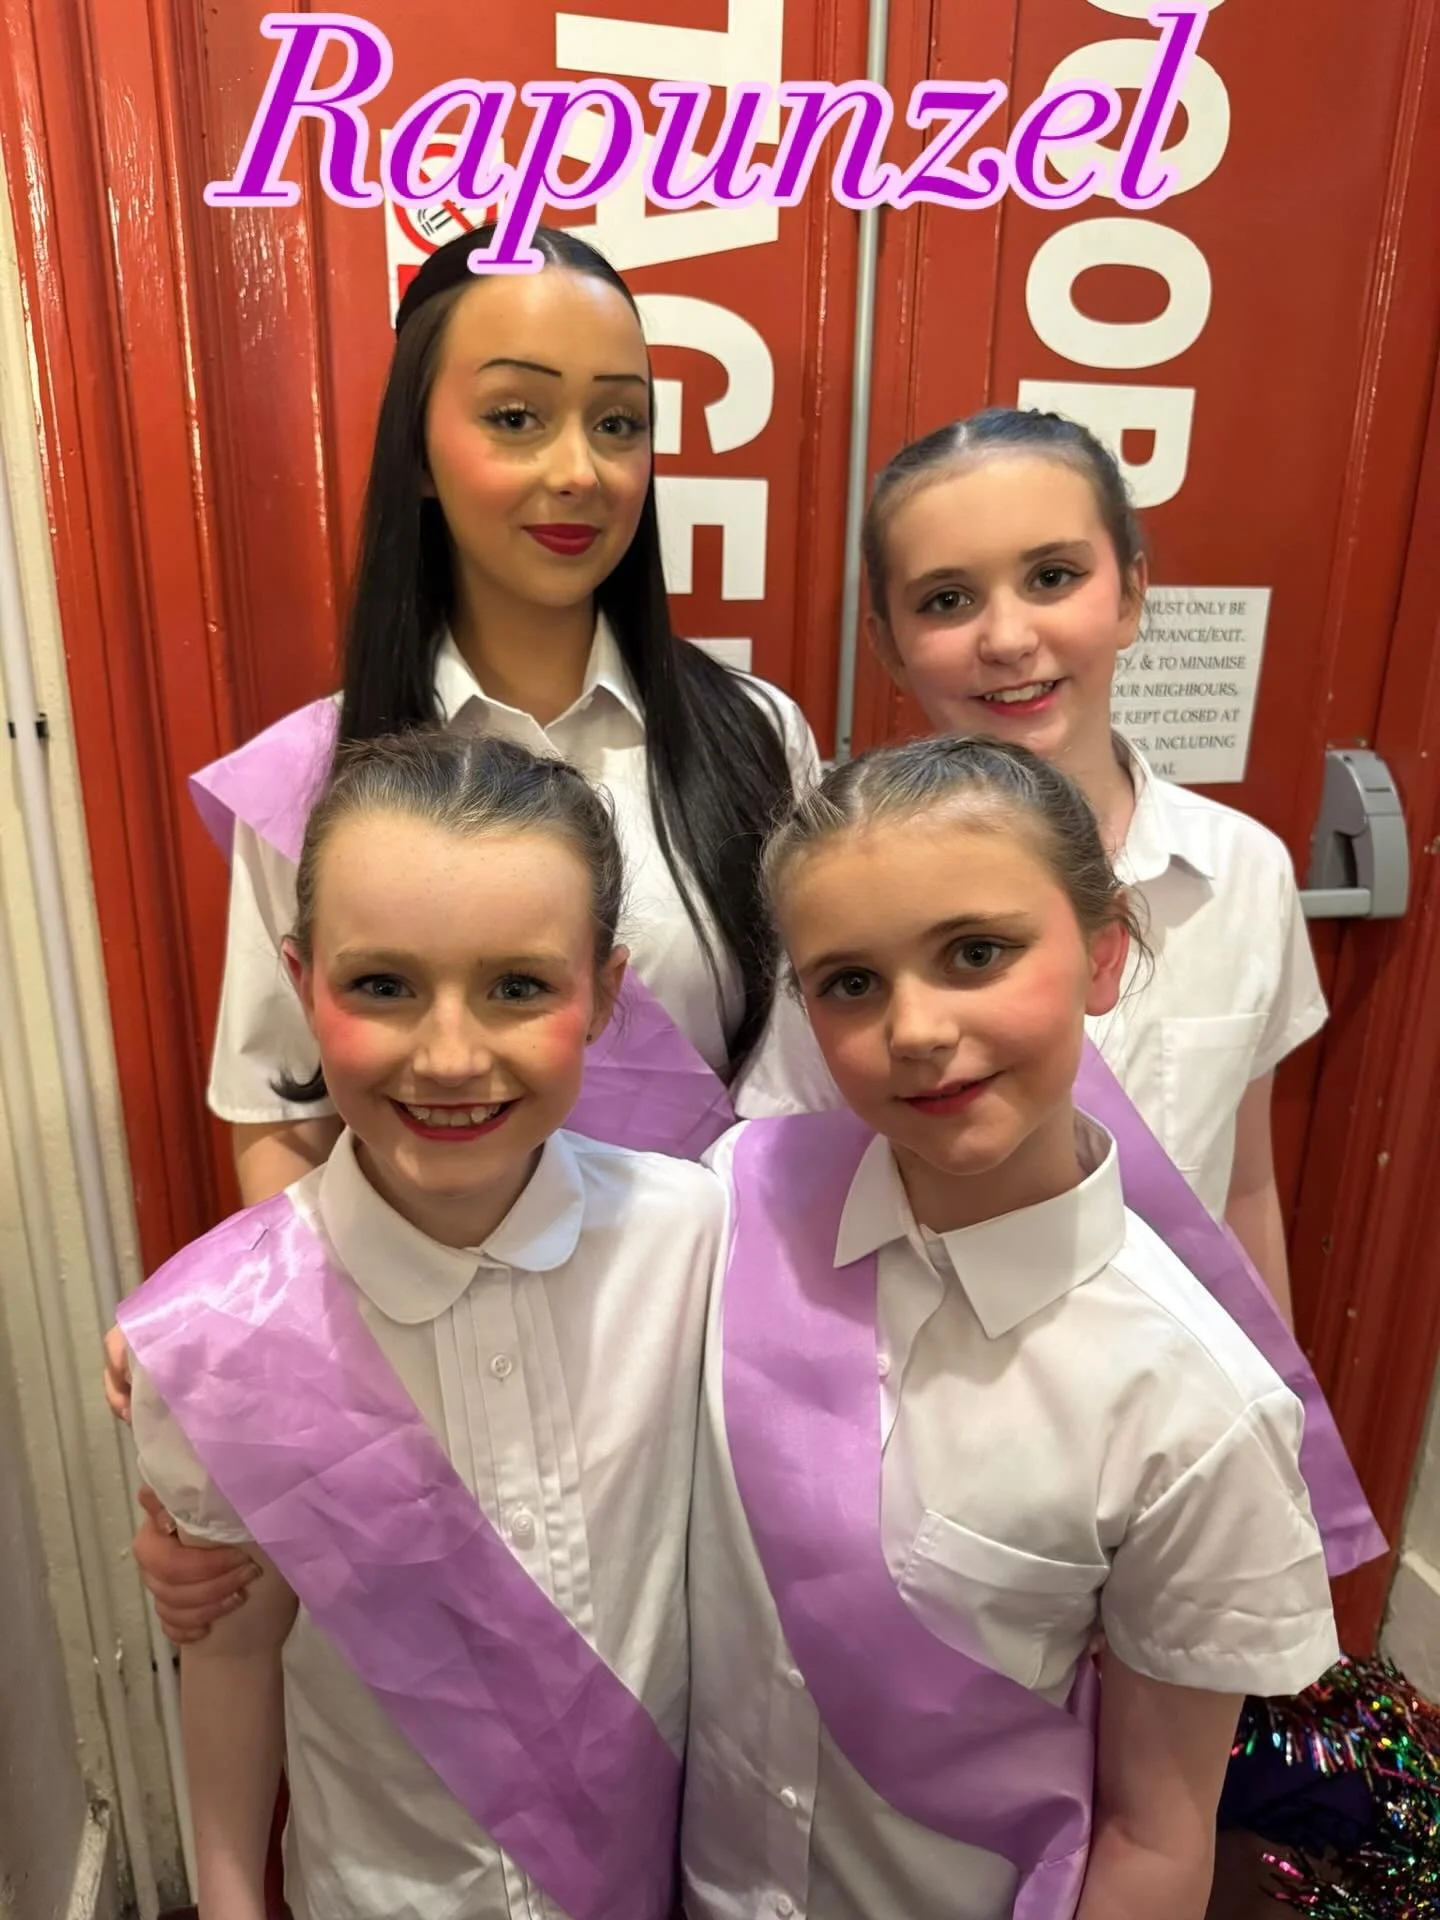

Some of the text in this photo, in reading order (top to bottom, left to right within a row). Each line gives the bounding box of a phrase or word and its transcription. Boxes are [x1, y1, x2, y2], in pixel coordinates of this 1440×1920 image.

[1018, 0, 1231, 508] OOR
[1186, 601, 1225, 615] ONLY
[1229, 601, 1246, 615] BE
[1137, 626, 1245, 643] NTRANCE/EXIT.
[1140, 655, 1153, 670] &
[1159, 656, 1178, 670] TO
[1180, 655, 1246, 669] MINIMISE
[1124, 710, 1160, 725] KEPT
[1163, 709, 1217, 724] CLOSED
[1220, 709, 1240, 723] AT
[1155, 735, 1235, 750] INCLUDING
